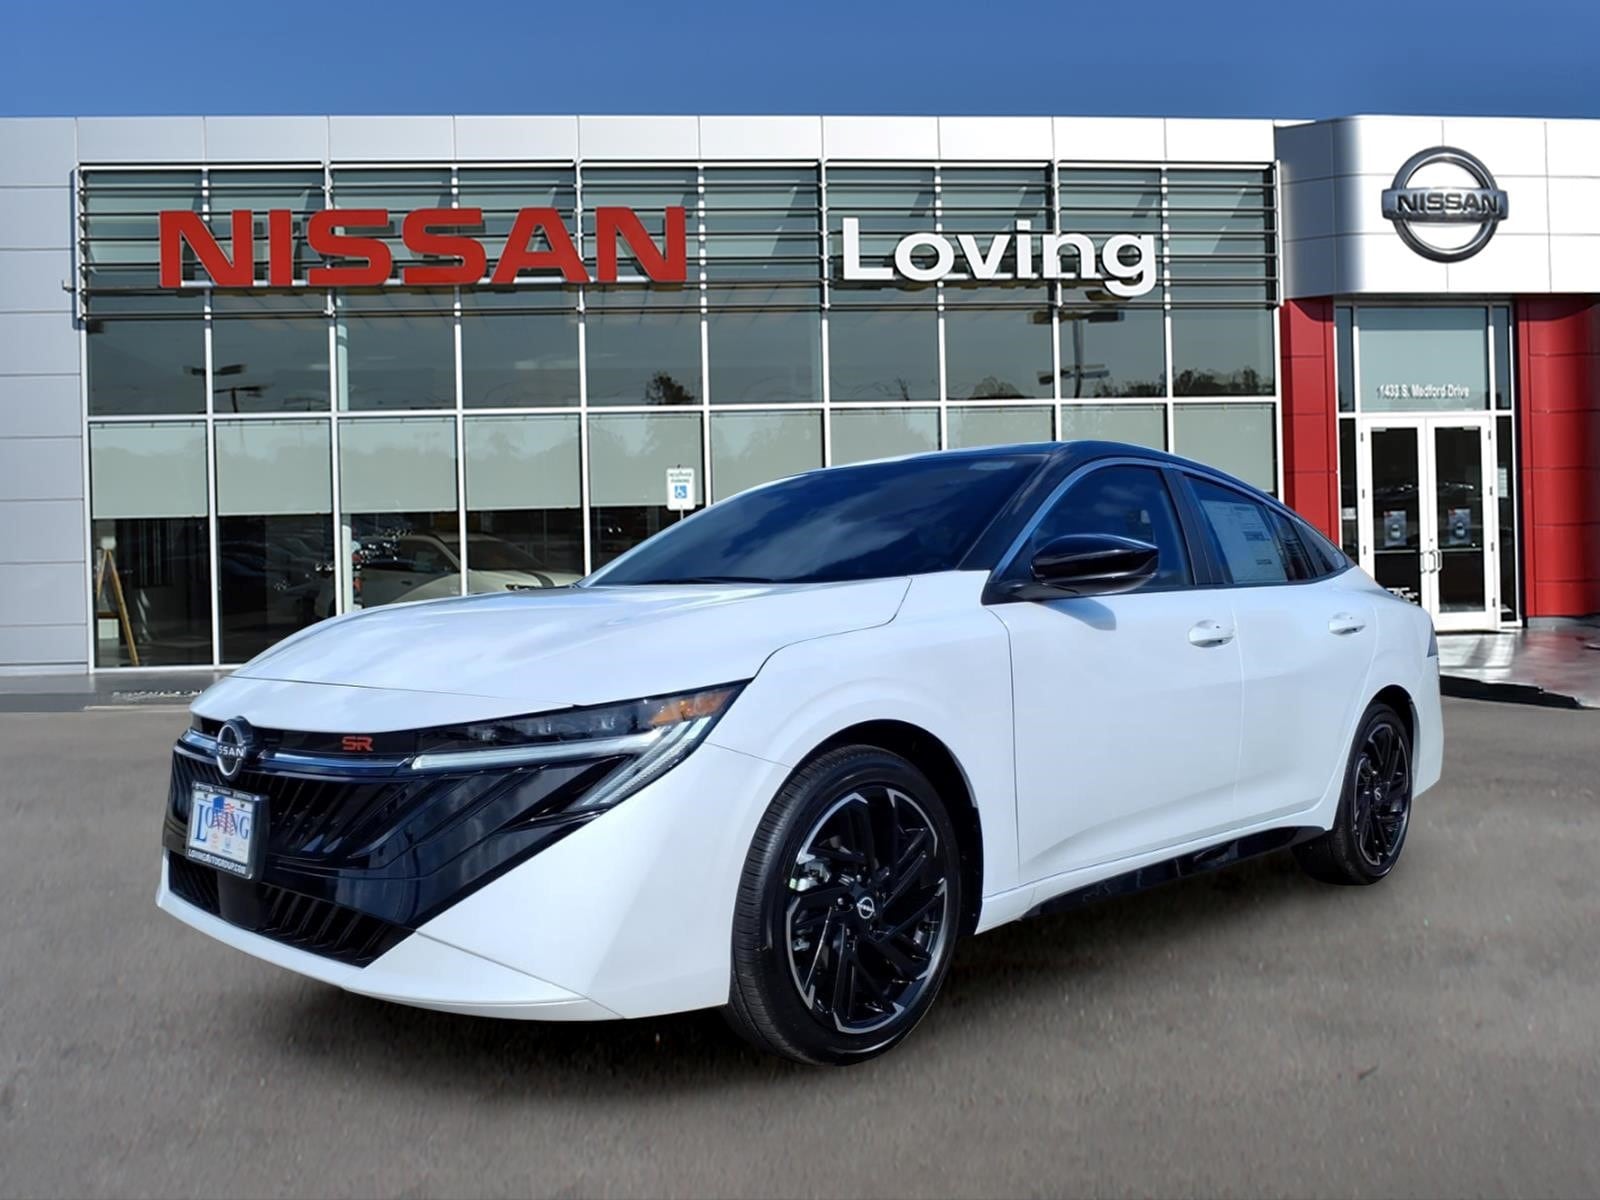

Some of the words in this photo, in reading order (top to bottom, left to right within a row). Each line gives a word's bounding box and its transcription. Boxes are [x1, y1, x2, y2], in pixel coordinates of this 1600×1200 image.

[1397, 192, 1498, 213] NISSAN
[158, 206, 688, 288] NISSAN
[842, 217, 1158, 298] Loving
[1401, 384, 1410, 398] S.
[1411, 383, 1446, 398] Medford
[1447, 383, 1470, 398] Drive
[218, 745, 247, 757] SSAN
[342, 736, 373, 751] SR
